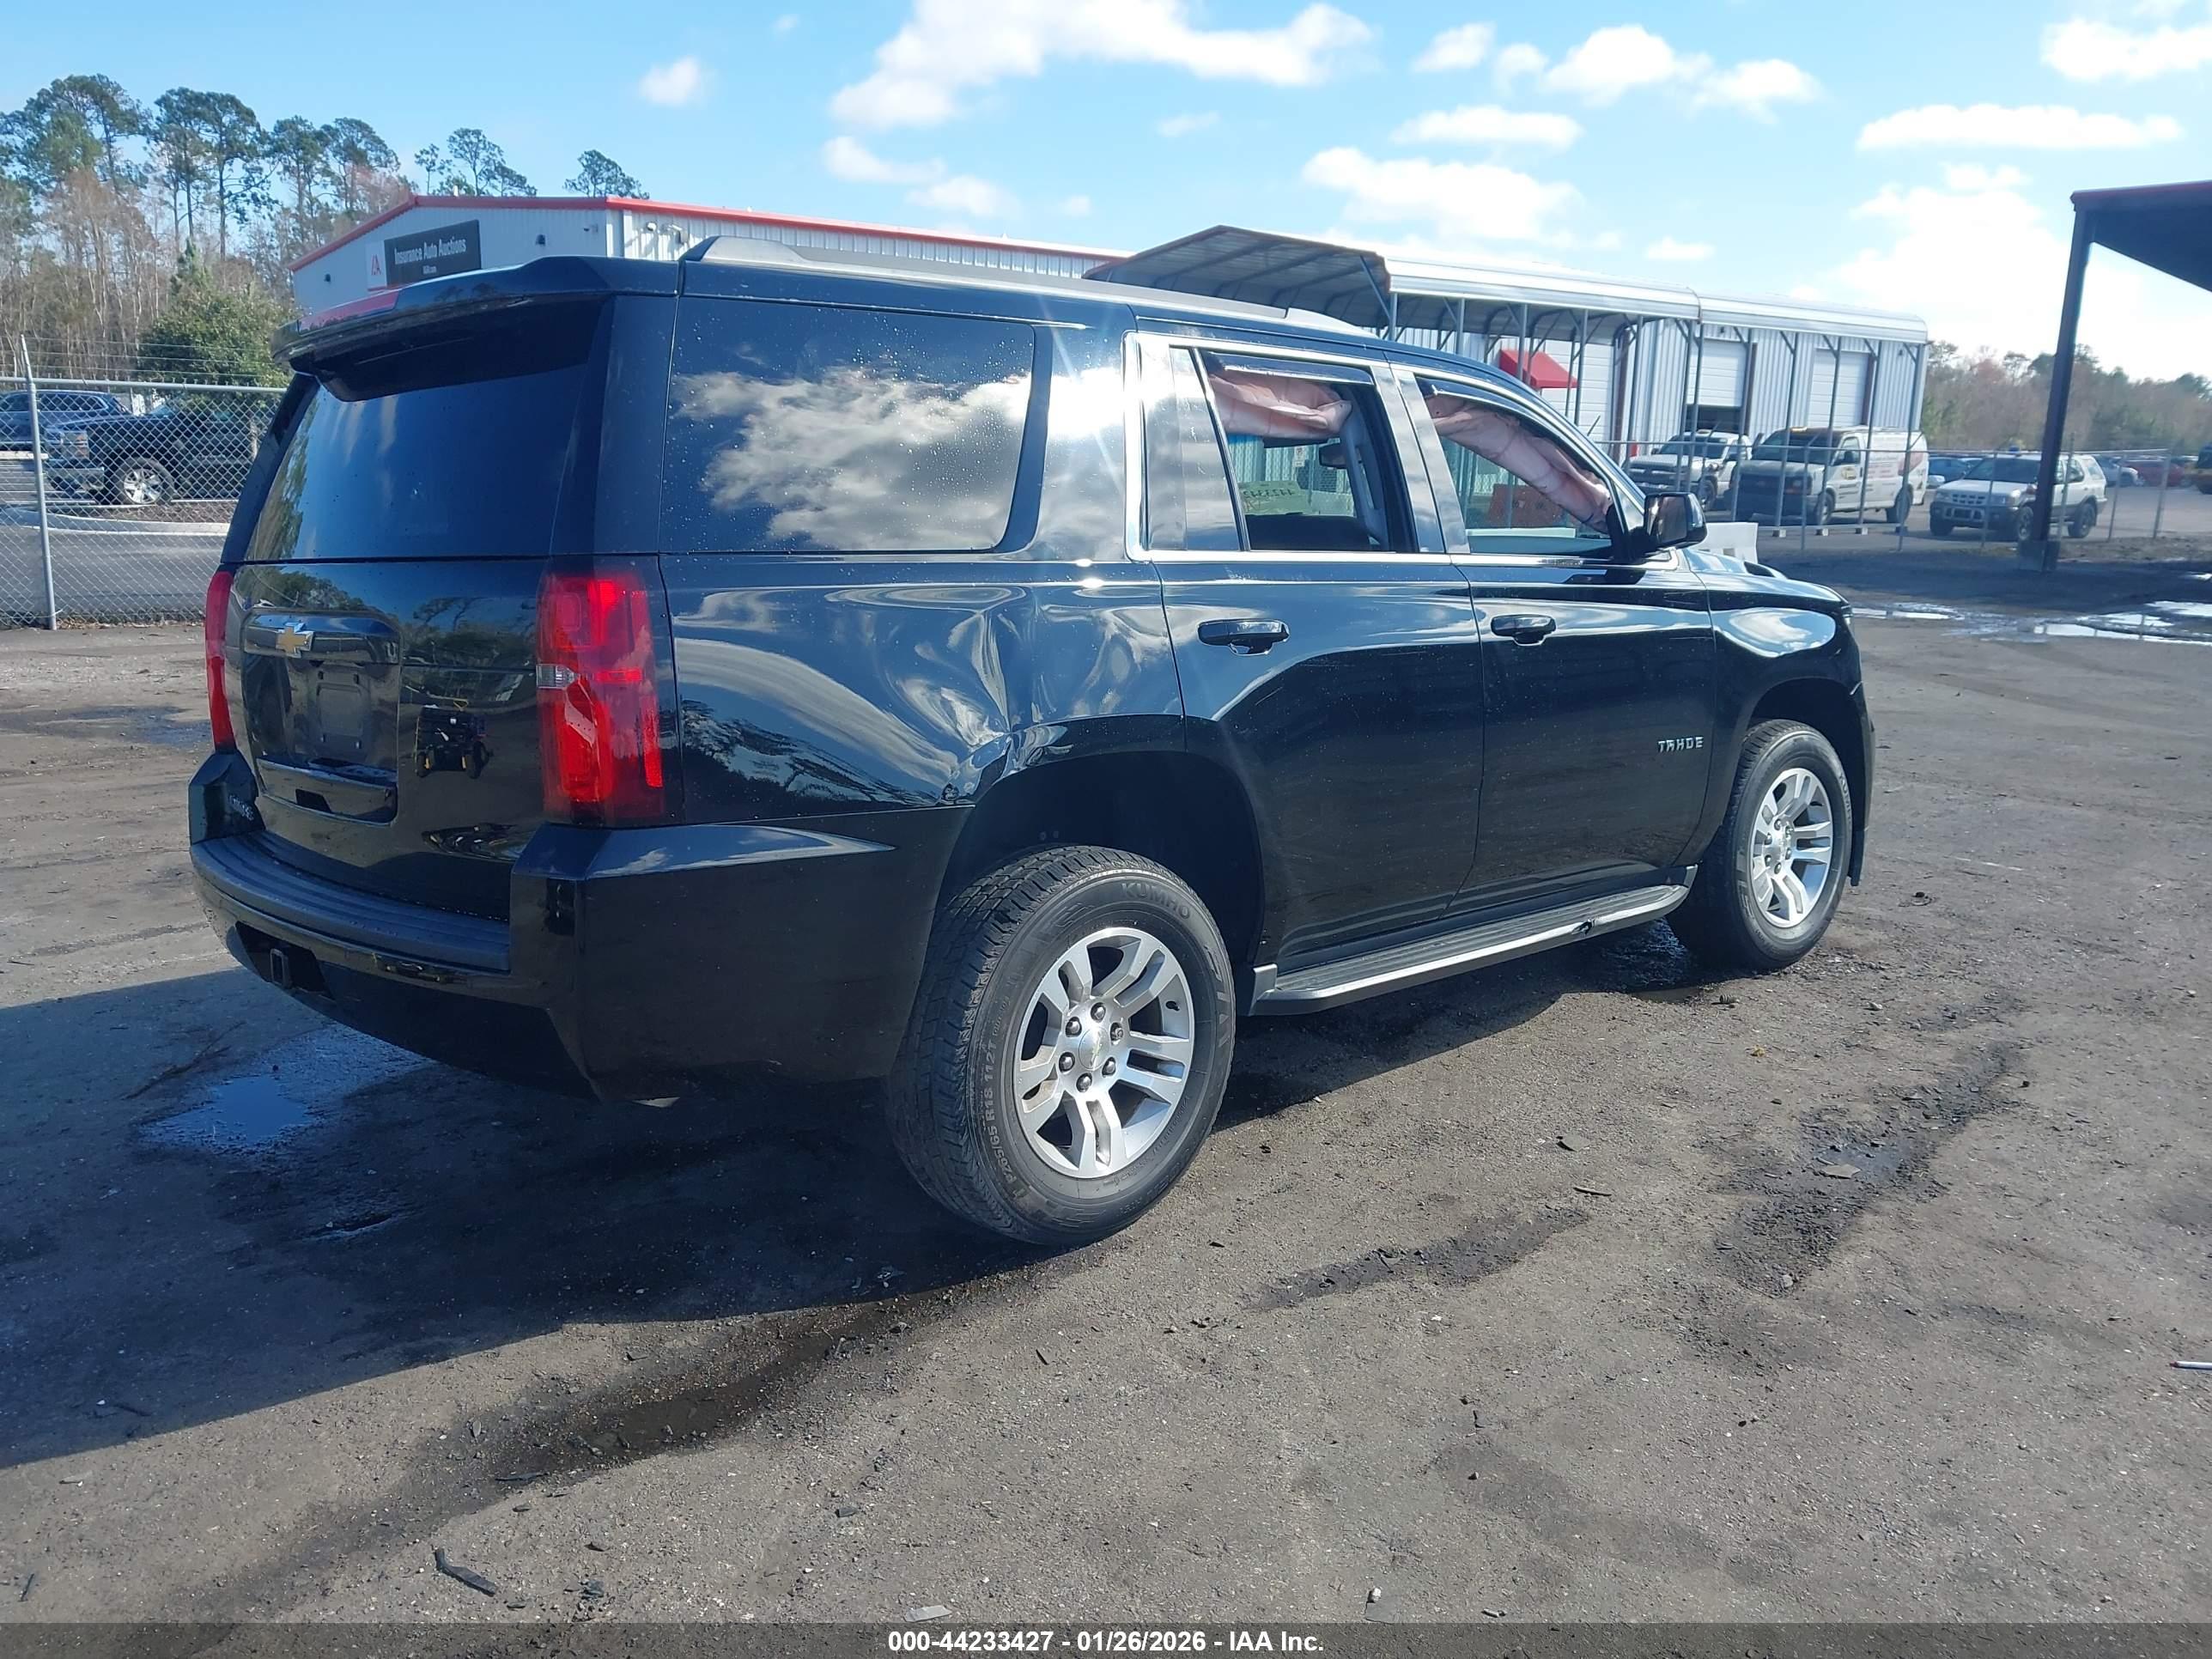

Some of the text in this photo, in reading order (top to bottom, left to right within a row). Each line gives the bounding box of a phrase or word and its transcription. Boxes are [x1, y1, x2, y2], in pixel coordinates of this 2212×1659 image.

[394, 236, 466, 264] Insurance Auto Auctions
[1657, 736, 1704, 753] TAHOE
[1119, 882, 1191, 918] KUMHO
